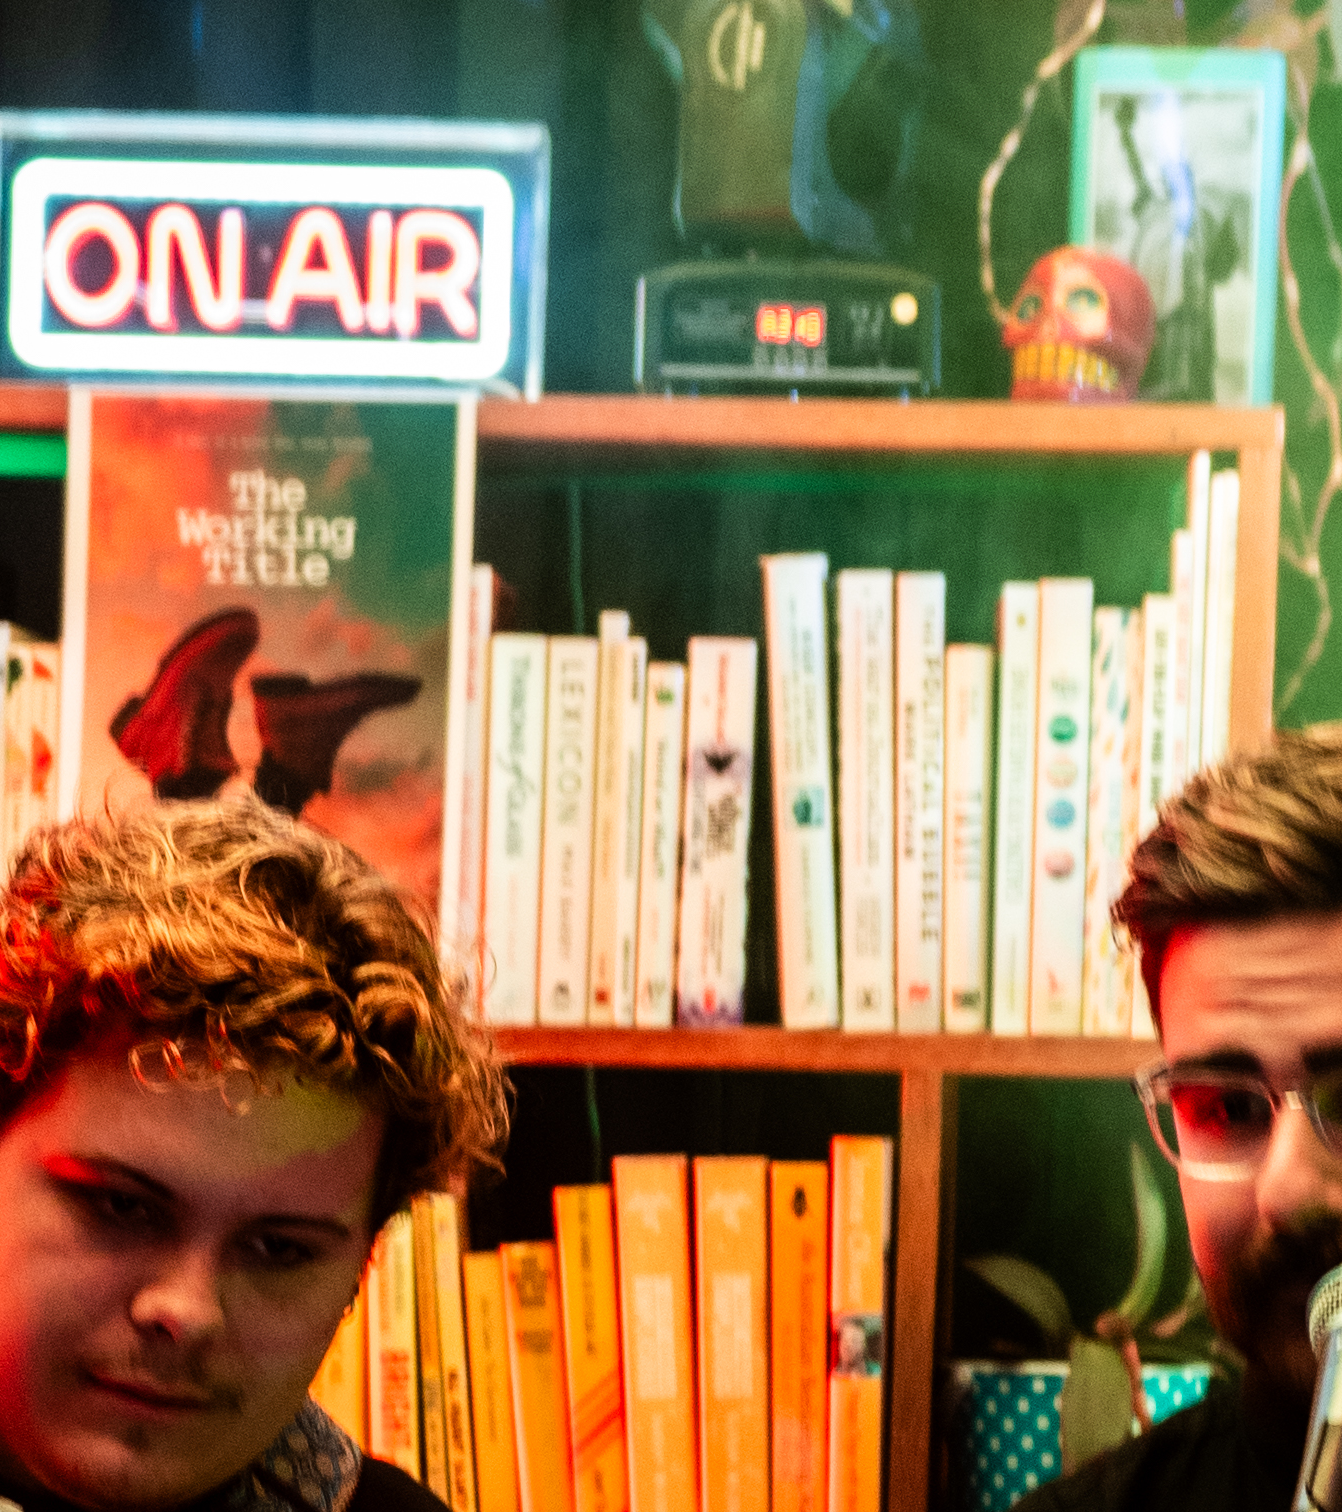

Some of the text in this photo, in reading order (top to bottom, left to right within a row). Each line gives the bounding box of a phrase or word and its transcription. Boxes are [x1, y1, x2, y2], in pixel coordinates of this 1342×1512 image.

[43, 202, 481, 340] ON AIR
[229, 469, 307, 511] The
[176, 508, 357, 561] Working
[201, 545, 331, 587] Title
[556, 660, 587, 826] LEXICON
[920, 830, 940, 943] BUBBLE
